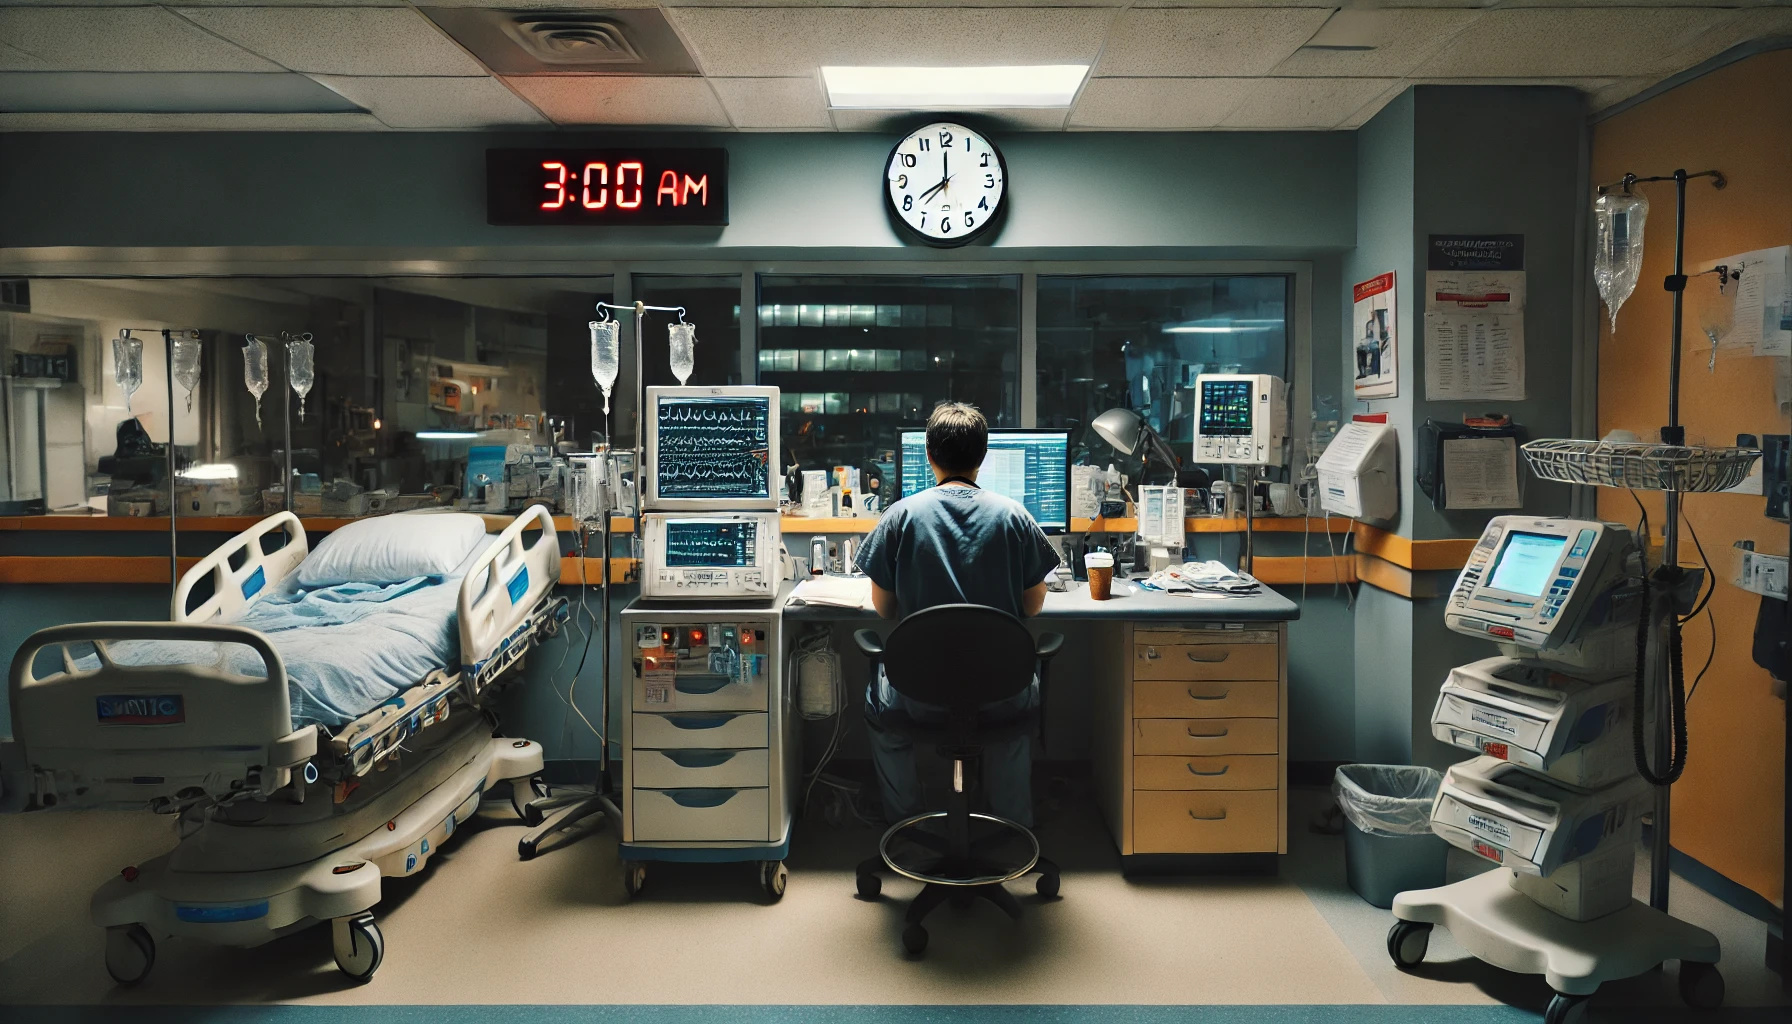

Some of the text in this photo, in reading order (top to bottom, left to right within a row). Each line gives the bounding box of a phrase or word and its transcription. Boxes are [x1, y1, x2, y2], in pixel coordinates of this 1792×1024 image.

[918, 137, 930, 152] 11
[939, 131, 953, 148] 12
[965, 137, 971, 152] 1
[899, 153, 917, 167] 10
[541, 162, 707, 208] 3:00 AM
[898, 174, 908, 189] 9
[984, 174, 994, 188] 3
[902, 194, 913, 211] 8
[941, 216, 952, 233] 6
[964, 211, 975, 228] 5
